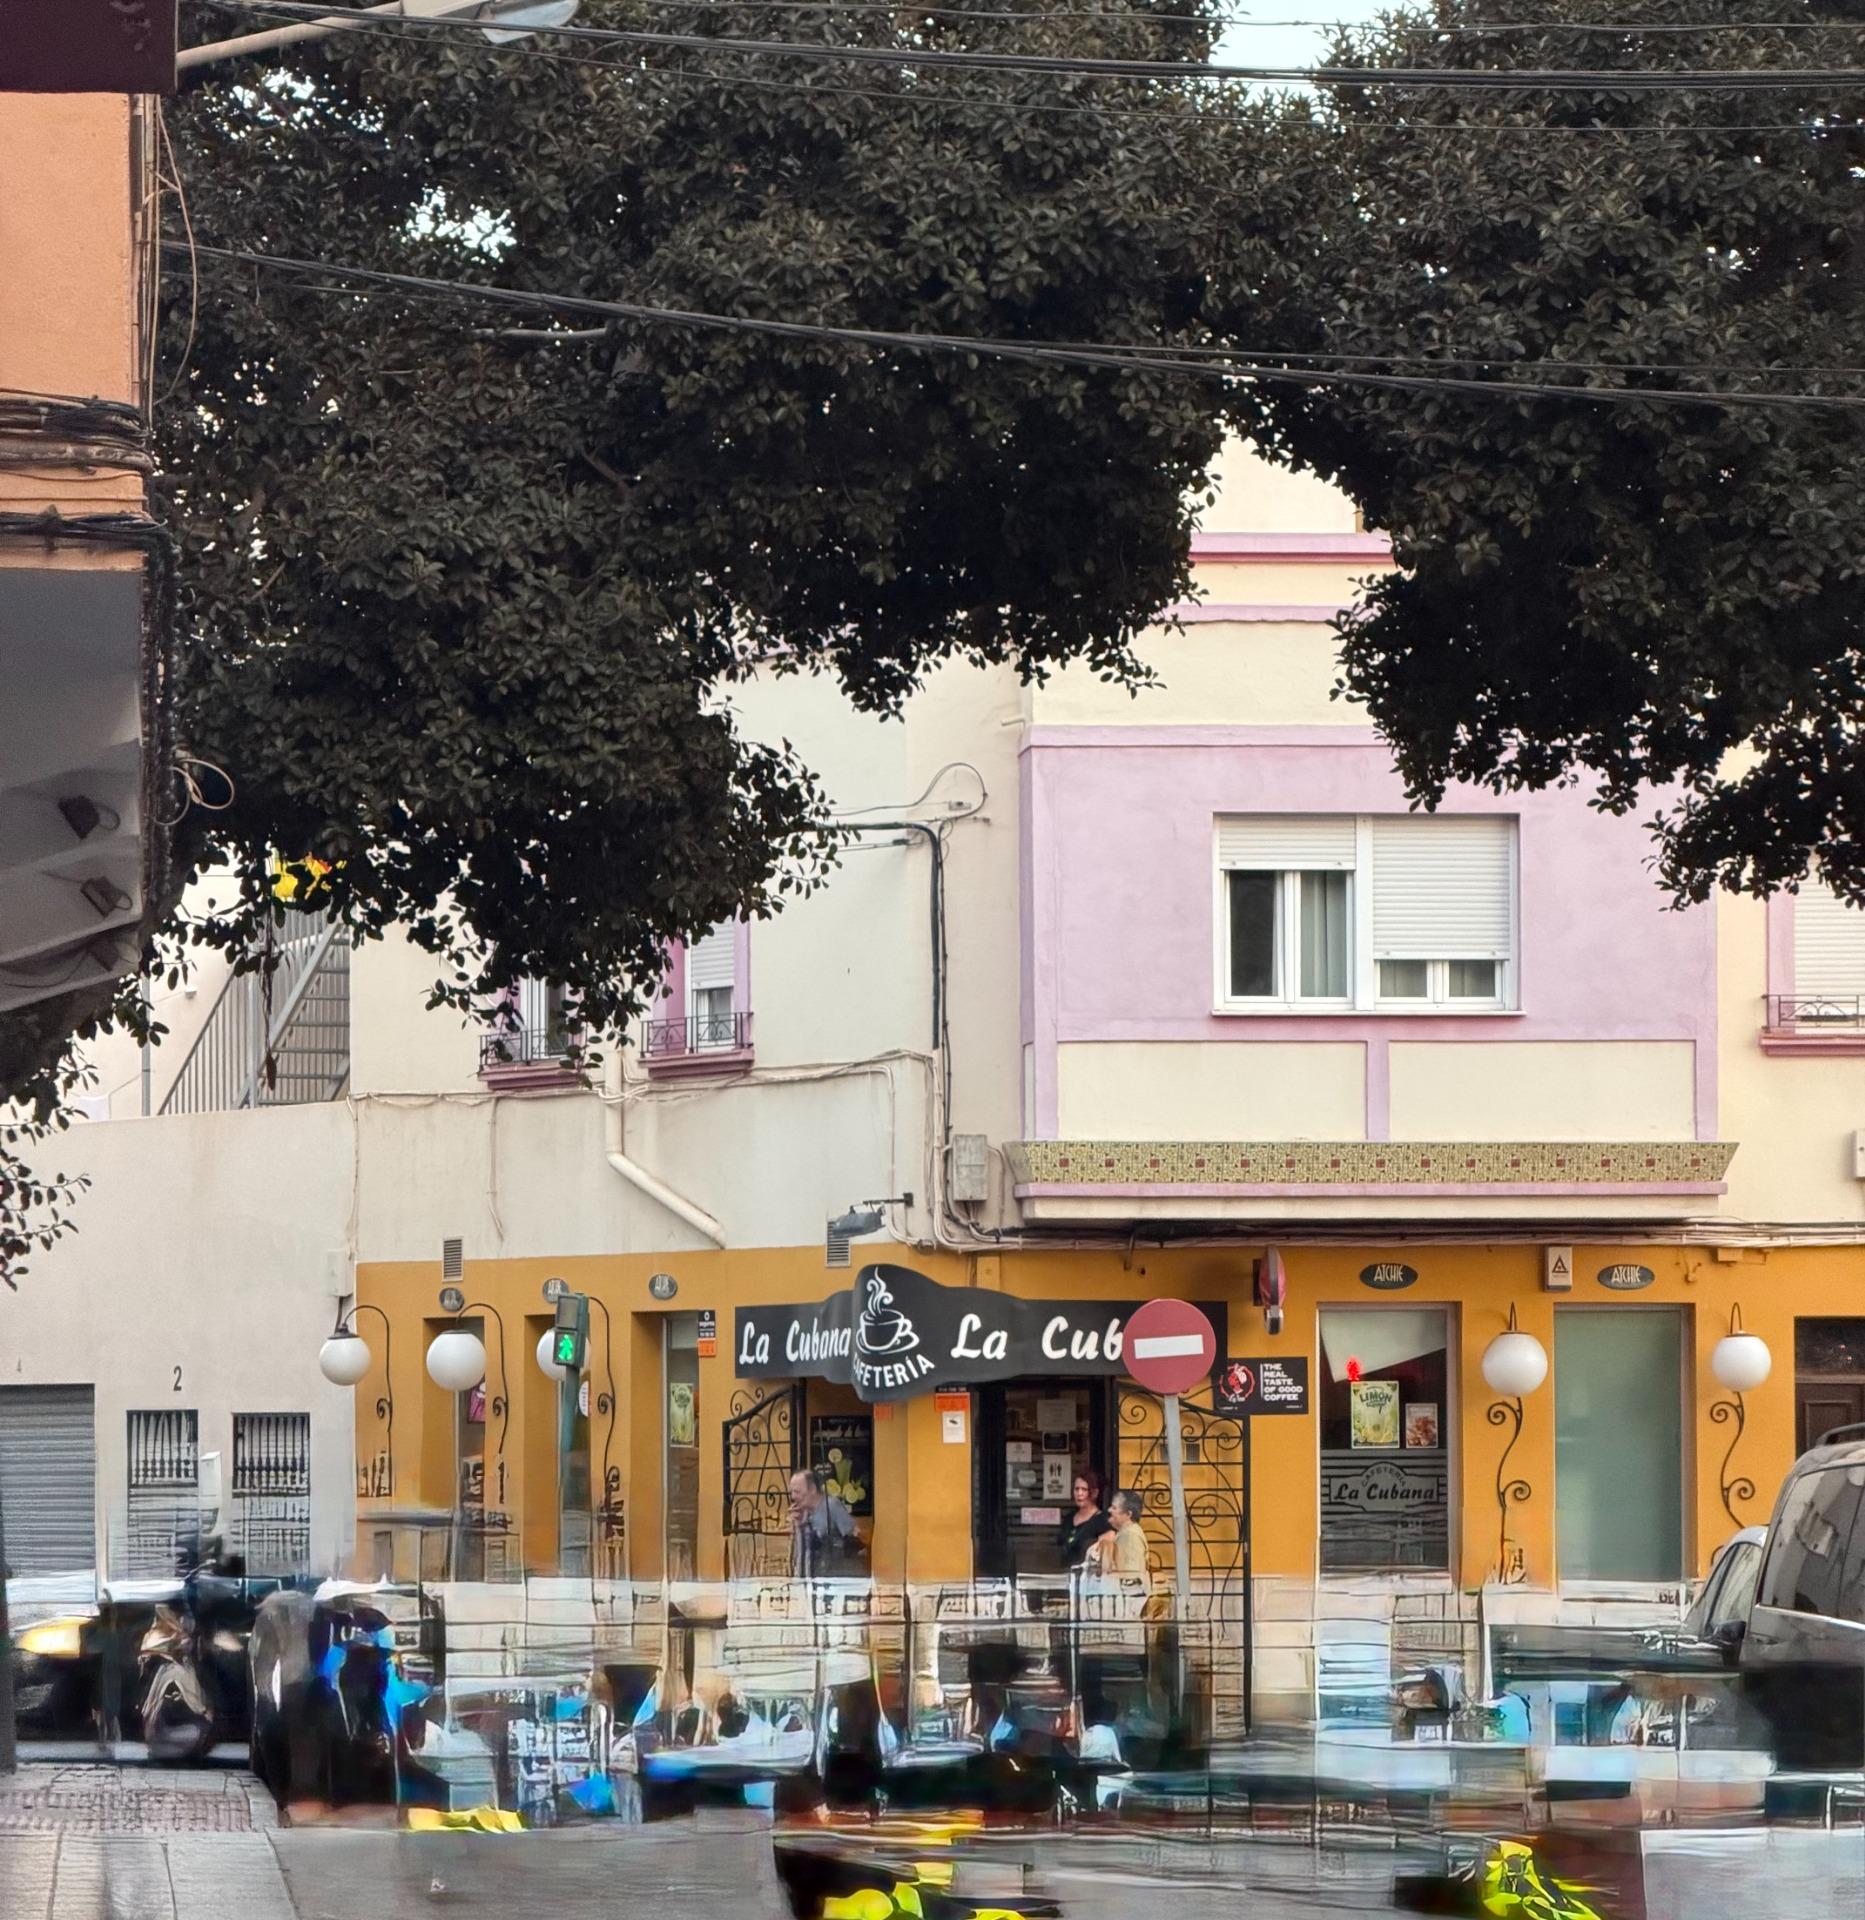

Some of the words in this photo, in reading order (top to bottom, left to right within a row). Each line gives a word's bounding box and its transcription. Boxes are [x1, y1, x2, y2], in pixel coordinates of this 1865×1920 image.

[739, 1321, 770, 1365] La
[785, 1317, 851, 1362] Cubana
[950, 1313, 1008, 1360] La
[1041, 1315, 1123, 1361] Cub
[173, 1365, 182, 1392] 2
[852, 1352, 935, 1388] CAFETERÍA
[1263, 1378, 1293, 1386] TASTE
[1278, 1385, 1303, 1393] GOOD
[1263, 1393, 1299, 1401] COFFEE
[1333, 1483, 1359, 1500] La
[1366, 1483, 1434, 1500] Cubana
